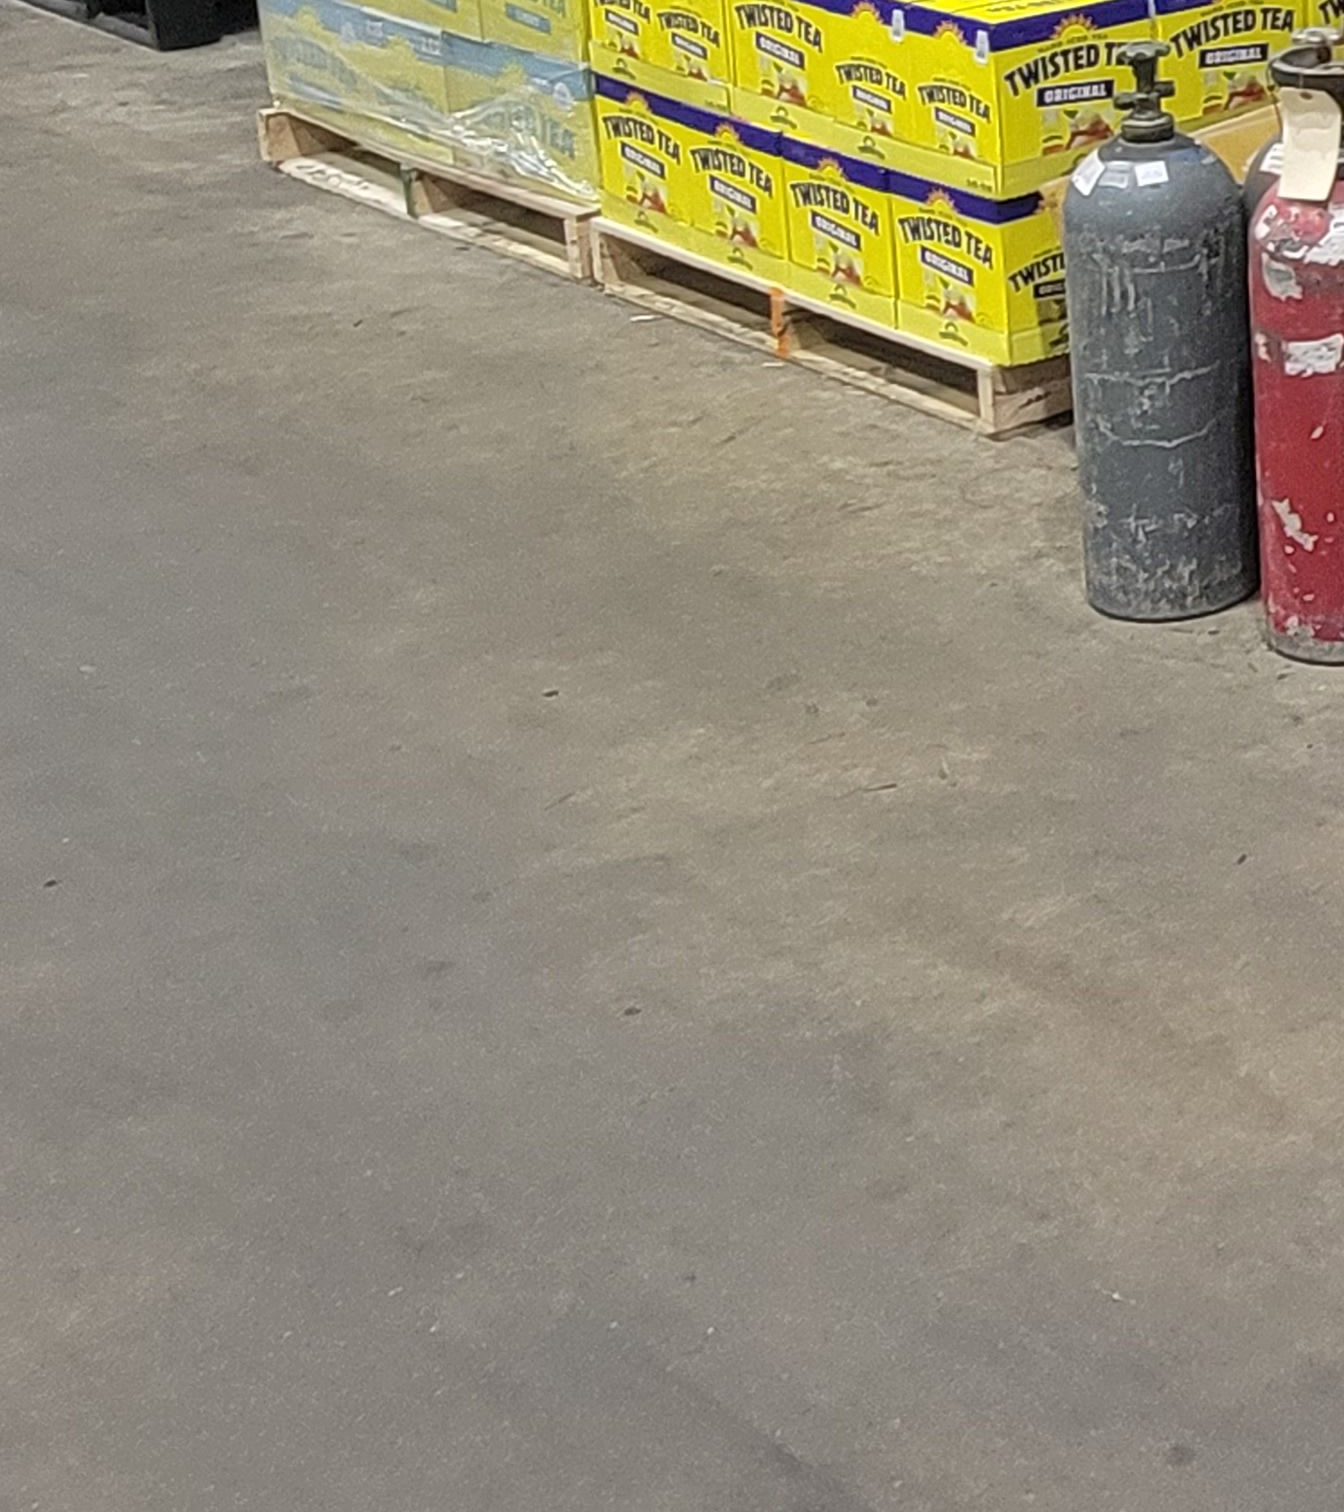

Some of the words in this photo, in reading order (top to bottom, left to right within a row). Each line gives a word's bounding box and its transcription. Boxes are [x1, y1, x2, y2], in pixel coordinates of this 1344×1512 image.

[735, 3, 794, 34] TWISTED
[795, 14, 823, 53] TEA
[1170, 9, 1256, 58] TWISTED
[1260, 7, 1295, 32] TEA
[835, 63, 883, 85] TWISTED
[884, 71, 907, 100] TEA
[1004, 43, 1100, 96] TWISTED
[917, 85, 967, 106] TWISTED
[969, 94, 991, 124] TEA
[602, 115, 656, 145] TWISTED
[657, 129, 681, 166] TEA
[690, 148, 746, 178] TWISTED
[748, 162, 773, 198] TEA
[789, 181, 851, 209] TWISTED
[853, 196, 880, 236] TEA
[898, 216, 962, 249] TWISTED
[964, 228, 994, 270] TEA
